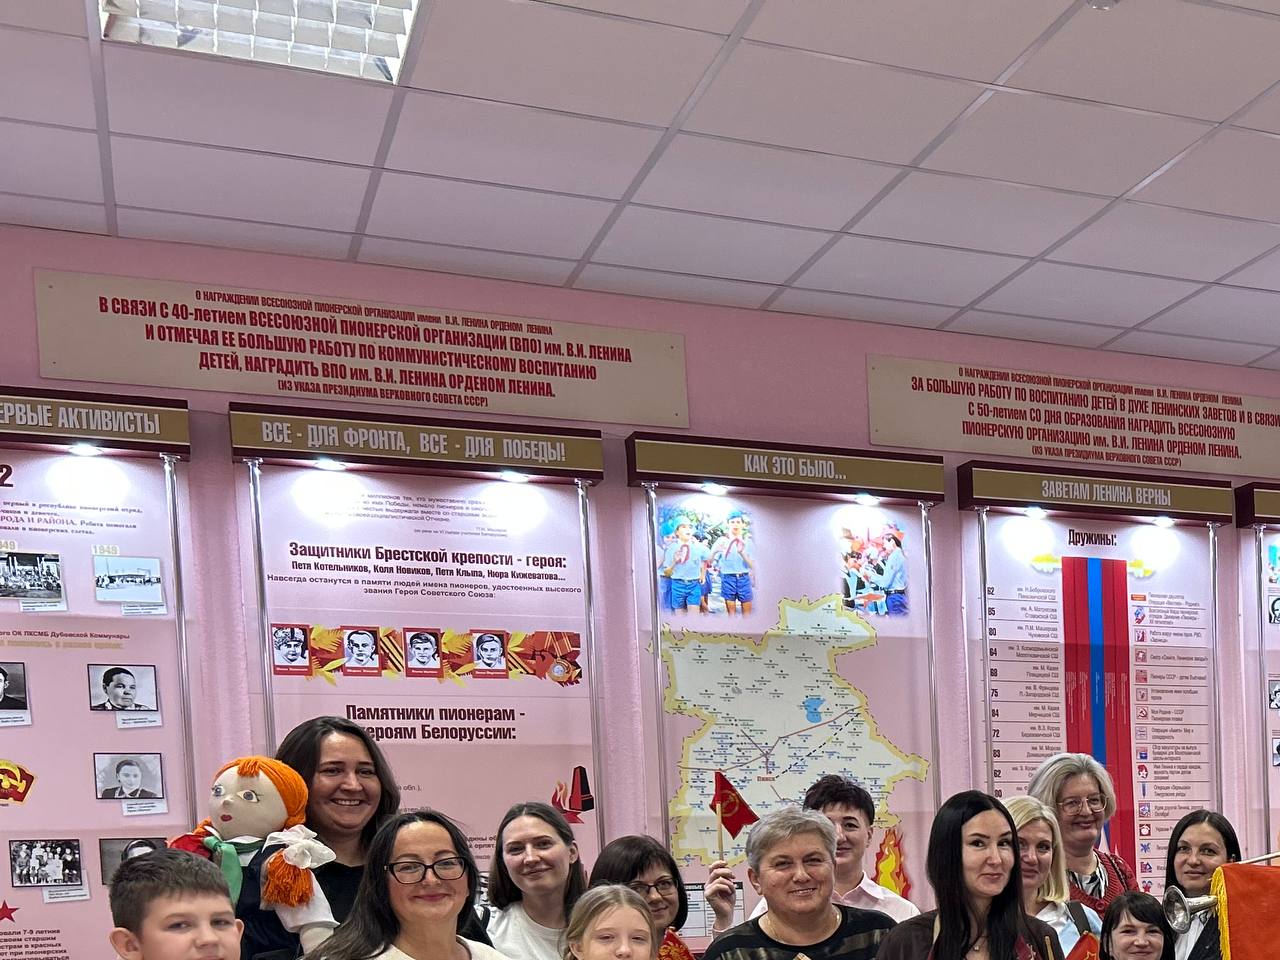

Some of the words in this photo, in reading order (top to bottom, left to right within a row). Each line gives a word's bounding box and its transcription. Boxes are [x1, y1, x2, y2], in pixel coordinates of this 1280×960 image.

[112, 298, 156, 317] СВЯЗИ
[172, 304, 246, 325] 40-летием
[250, 310, 337, 333] ВСЕСОЮЗНОЙ
[341, 319, 421, 343] ПИОНЕРСКОЙ
[424, 330, 507, 351] ОРГАНИЗАЦИИ
[510, 336, 541, 353] (ВПО)
[589, 344, 632, 362] ЛЕНИНА
[158, 327, 218, 346] ОТМЕЧАЯ
[238, 334, 306, 353] БОЛЬШУЮ
[309, 341, 358, 359] РАБОТУ
[378, 344, 517, 373] КОММУНИСТИЧЕСКОМУ
[519, 358, 597, 380] ВОСПИТАНИЮ
[200, 352, 242, 371] ДЕТЕЙ,
[245, 356, 319, 377] НАГРАДИТЬ
[399, 371, 446, 388] ЛЕНИНА
[449, 374, 506, 393] ОРДЕНОМ
[508, 379, 555, 397] ЛЕНИНА.
[927, 378, 975, 396] БОЛЬШУЮ
[978, 384, 1011, 400] РАБОТУ
[1029, 389, 1089, 408] ВОСПИТАНИЮ
[1091, 395, 1117, 411] ДЕТЕЙ
[1128, 400, 1149, 414] ДУХЕ
[1151, 402, 1200, 419] ЛЕНИНСКИХ
[1202, 407, 1236, 422] ЗАВЕТОВ
[1255, 412, 1280, 427] СВЯЗИ
[58, 407, 160, 434] АКТИВИСТЫ
[977, 403, 1027, 421] 50-летием
[1044, 410, 1061, 425] ДНЯ
[1064, 412, 1125, 431] ОБРАЗОВАНИЯ
[1128, 420, 1175, 435] НАГРАДИТЬ
[1178, 423, 1235, 440] ВСЕСОЮЗНУЮ
[262, 421, 292, 444] ВСЕ
[307, 424, 339, 448] ДЛЯ
[344, 428, 411, 455] ФРОНТА,
[420, 434, 448, 455] ВСЕ
[465, 436, 494, 458] ДЛЯ
[503, 440, 566, 462] ПОБЕДЫ!
[962, 421, 1023, 440] ПИОНЕРСКУЮ
[1027, 427, 1090, 446] ОРГАНИЗАЦИЮ
[1132, 438, 1164, 452] ЛЕНИНА
[1167, 440, 1206, 456] ОРДЕНОМ
[1208, 444, 1241, 459] ЛЕНИНА.
[744, 454, 768, 474] КАК
[772, 457, 795, 476] ЭТО
[799, 458, 847, 480] БЫЛО...
[1042, 481, 1090, 500] ЗАВЕТАМ
[1092, 484, 1133, 503] ЛЕНИНА
[1136, 488, 1171, 506] ВЕРНЫ
[1069, 529, 1117, 546] Дружины:
[289, 542, 371, 560] Защитники
[375, 546, 447, 564] Брестской
[451, 552, 513, 566] крепости
[526, 555, 567, 569] героя:
[267, 575, 307, 585] Навсегда
[309, 577, 352, 585] останутся
[292, 561, 312, 570] Петя
[314, 562, 371, 573] Котельников,
[373, 565, 394, 573] Коля
[396, 565, 433, 577] Новиков,
[435, 568, 454, 576] Петя
[456, 569, 485, 579] Клыпа,
[487, 570, 509, 580] Нюра
[991, 689, 998, 697] 75
[346, 704, 434, 720] Памятники
[439, 707, 515, 721] пионерам
[421, 725, 516, 741] Белоруссии:
[992, 729, 999, 737] 72
